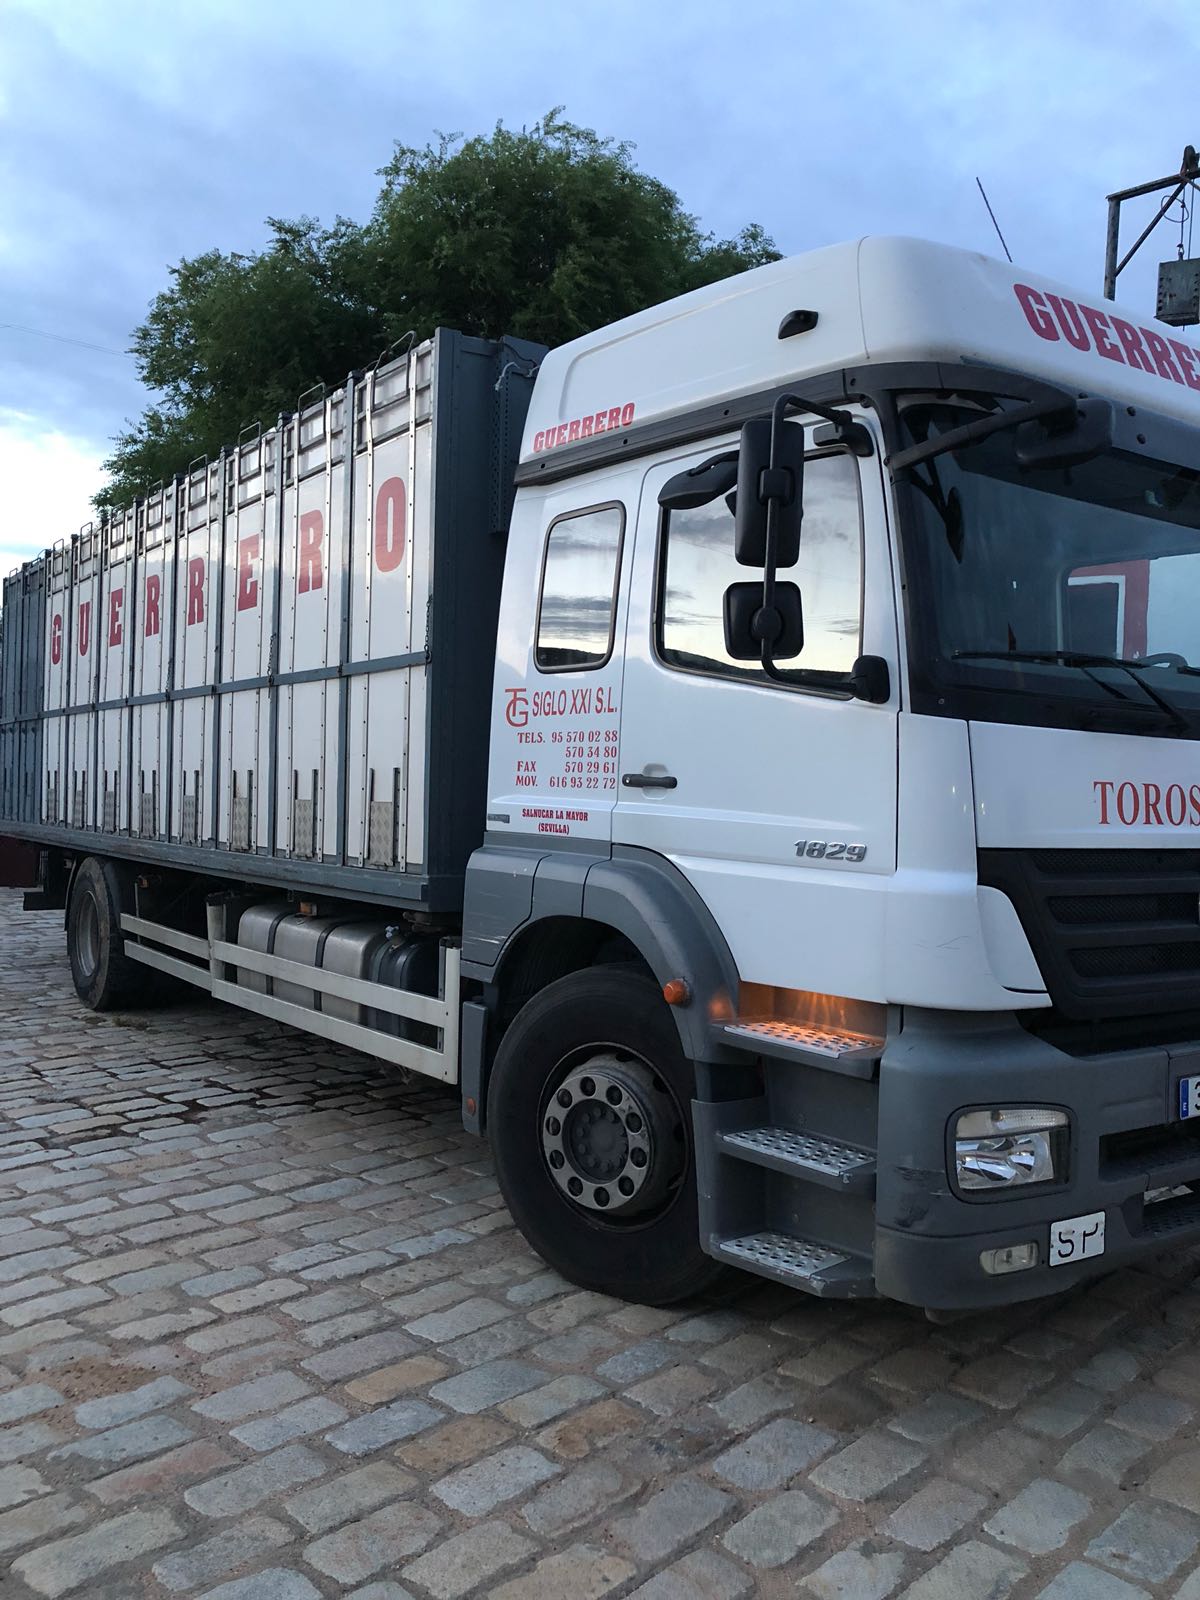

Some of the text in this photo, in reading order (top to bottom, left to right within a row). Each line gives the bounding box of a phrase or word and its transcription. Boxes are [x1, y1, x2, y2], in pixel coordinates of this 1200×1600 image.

[1013, 284, 1200, 392] GUERRE
[533, 402, 635, 453] GUERRERO
[52, 476, 407, 665] GUERRERO
[532, 690, 567, 717] SIGLO
[570, 688, 592, 715] XXI
[595, 686, 618, 715] S.L.
[517, 730, 618, 744] TELS. 95 570 02 88
[565, 746, 617, 758] 570 34 80
[517, 760, 616, 774] FAX 570 29 61
[515, 775, 616, 790] MOV. 616 93 22 72
[1093, 781, 1200, 827] TOROS
[522, 808, 589, 822] SALNUCAR LA MAYOR
[538, 823, 570, 835] (SEVILLA)
[794, 840, 867, 863] 1829
